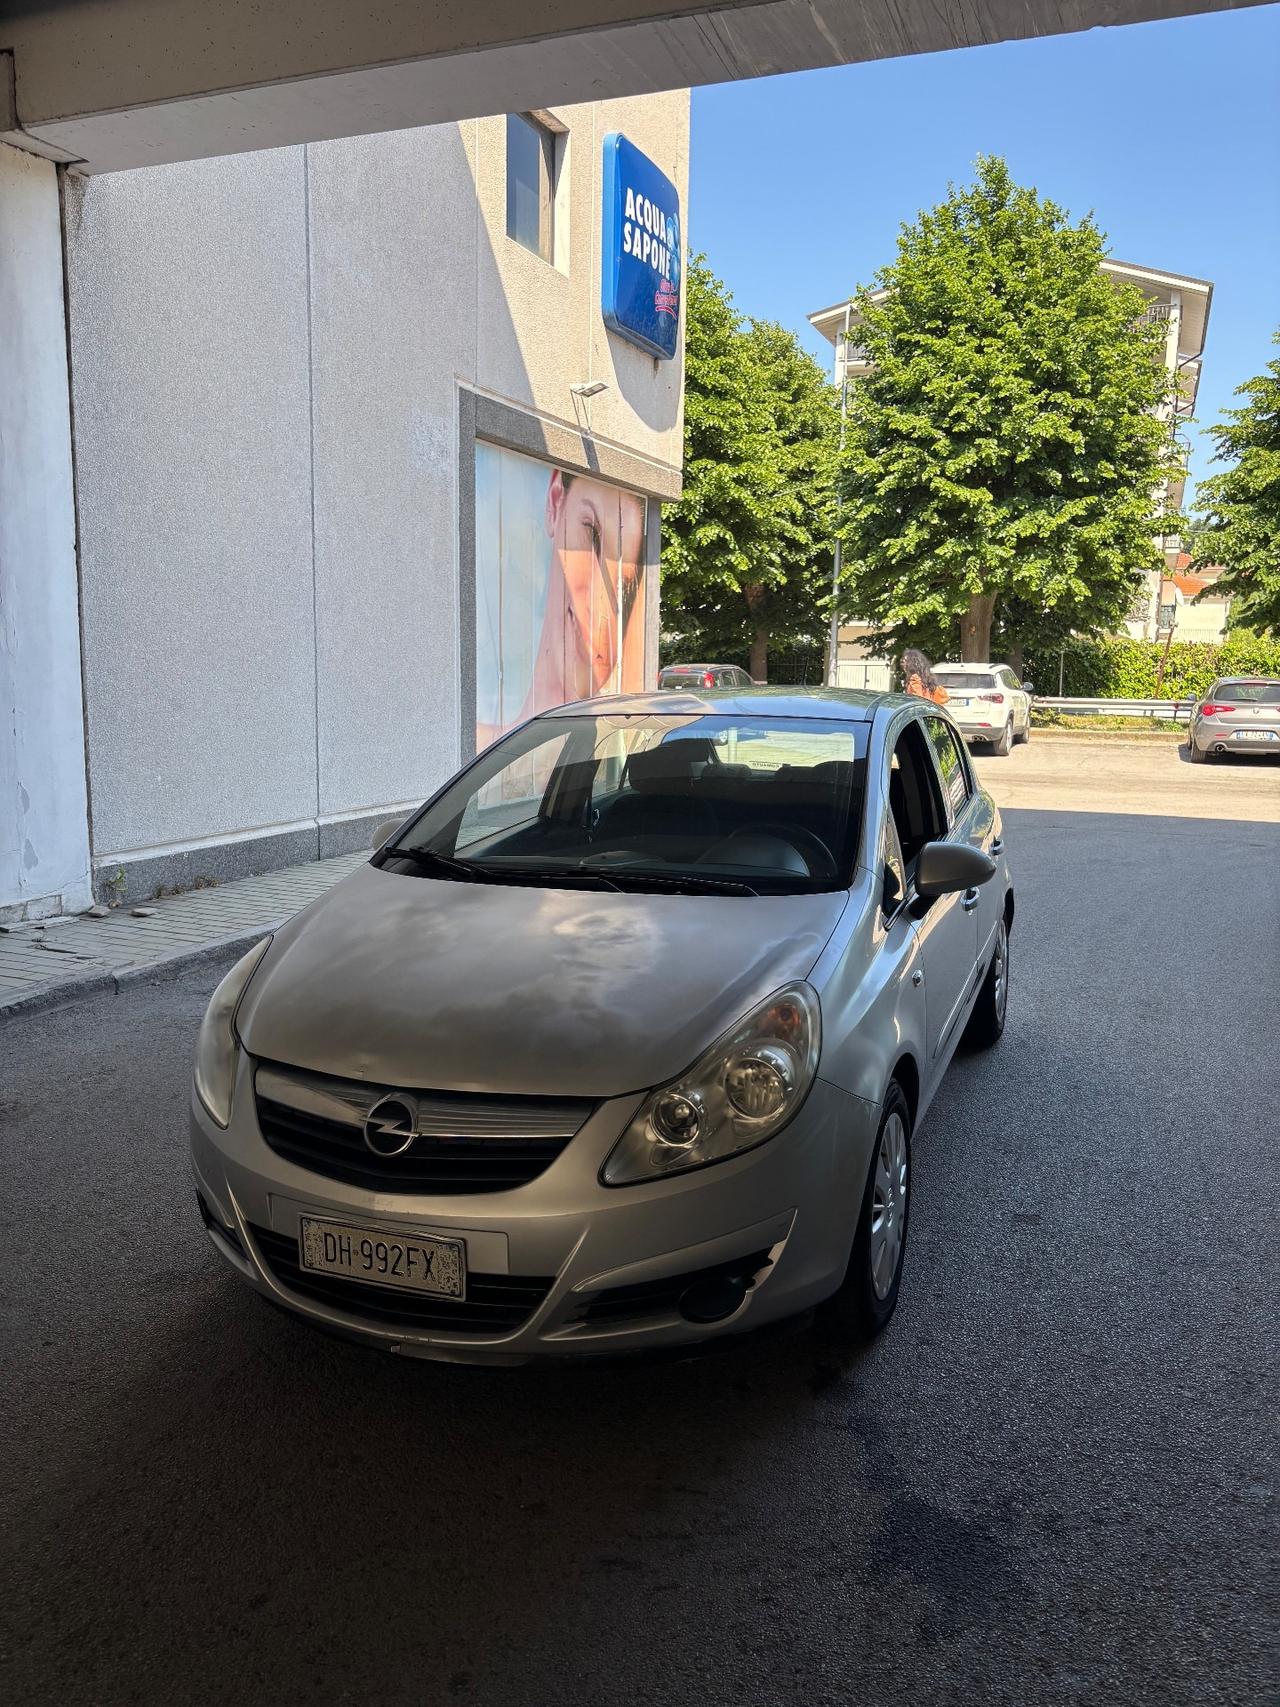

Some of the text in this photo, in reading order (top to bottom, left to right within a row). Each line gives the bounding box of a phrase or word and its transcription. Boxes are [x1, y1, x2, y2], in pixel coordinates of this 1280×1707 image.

[625, 187, 667, 242] ACQUA
[623, 222, 671, 281] SAPONE
[323, 1232, 436, 1282] DH 992FX
